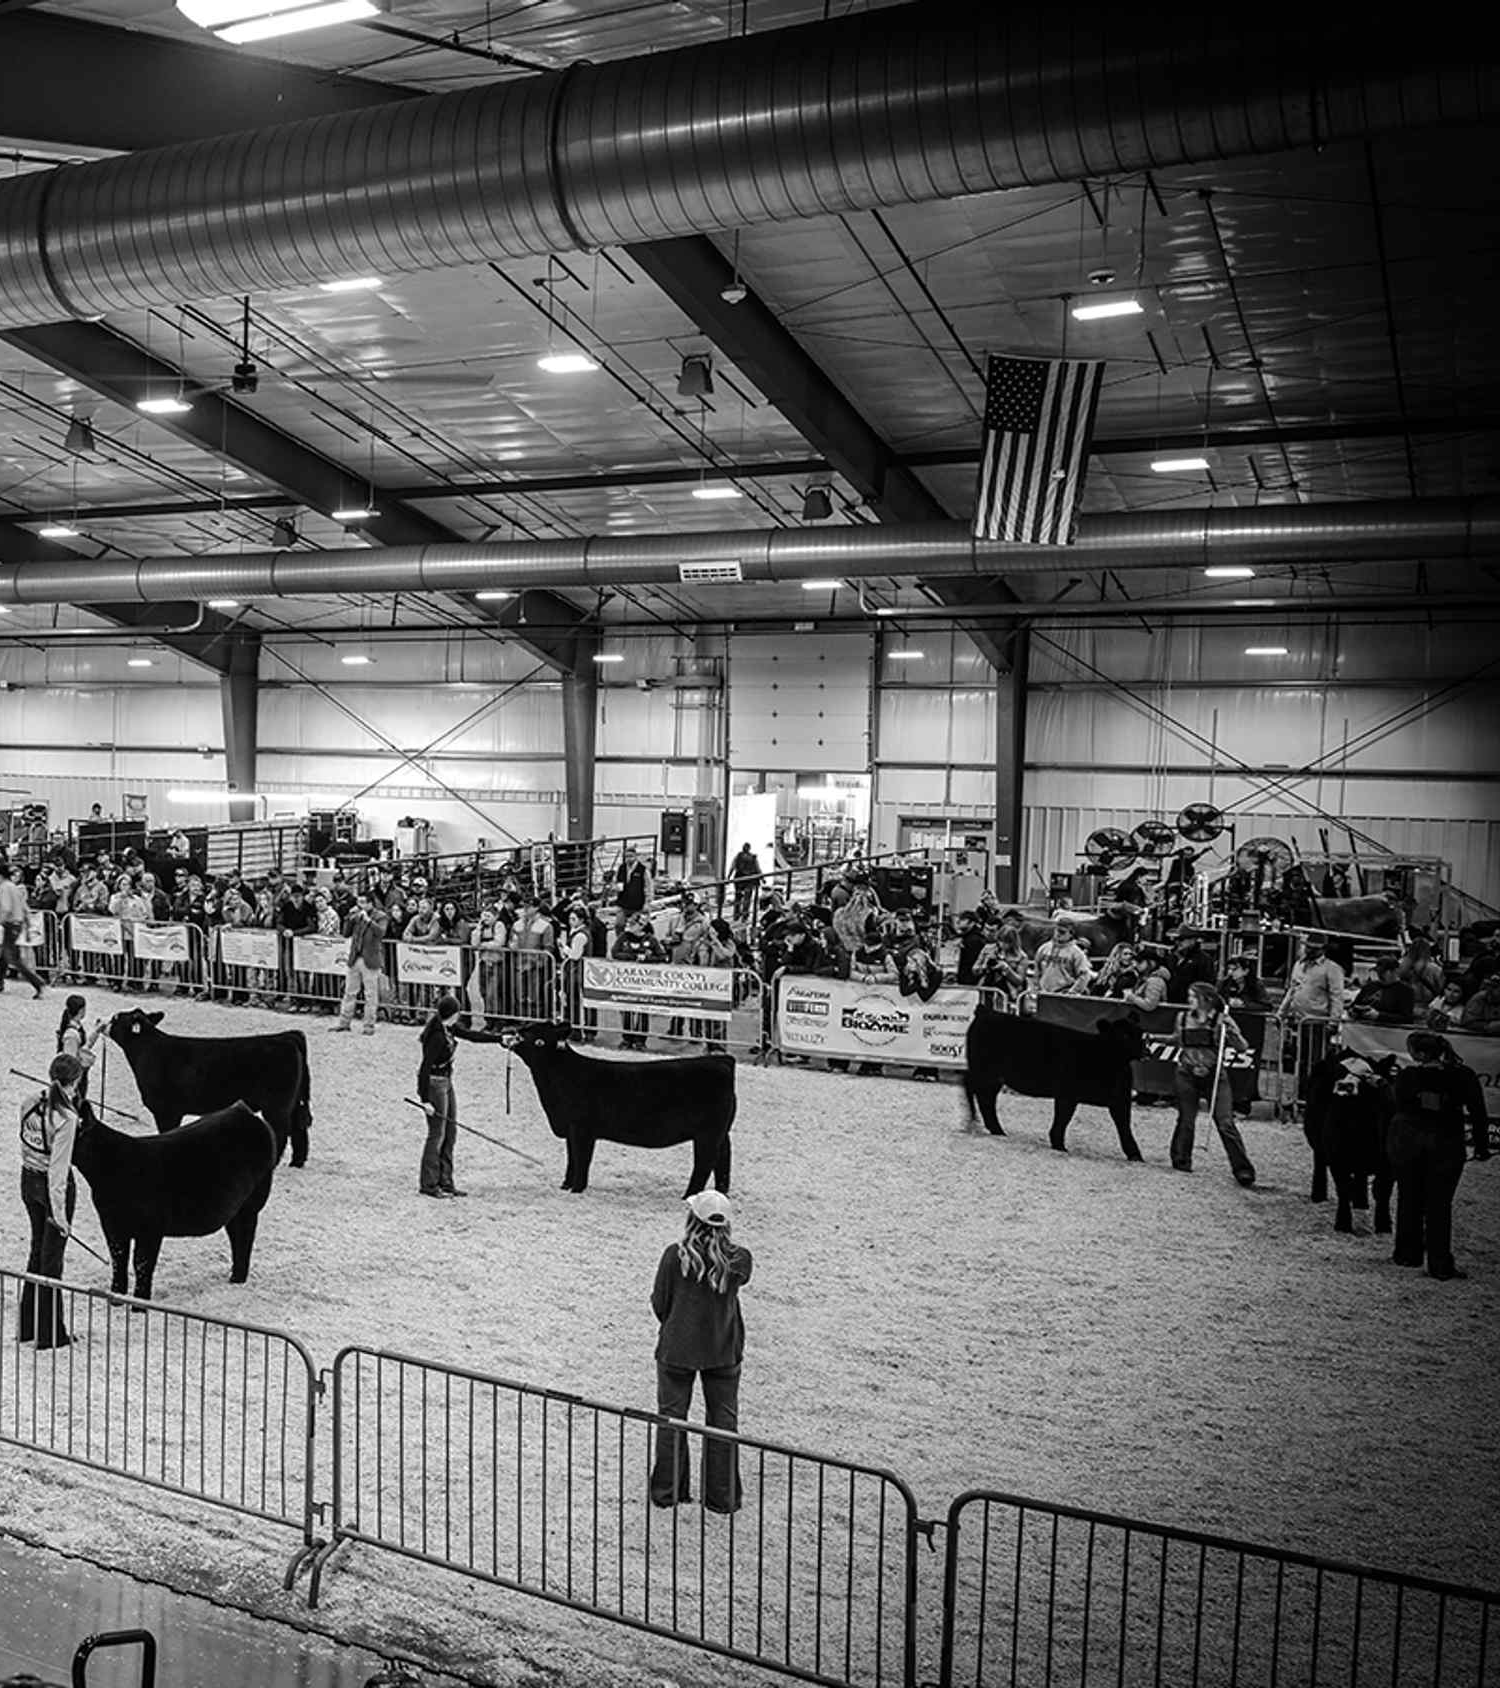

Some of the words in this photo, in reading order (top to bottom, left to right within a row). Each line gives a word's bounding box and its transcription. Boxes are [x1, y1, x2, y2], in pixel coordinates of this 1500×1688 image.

[664, 970, 707, 982] COUNTY
[615, 976, 680, 988] COMMUNITY
[682, 981, 730, 993] COLLEGE
